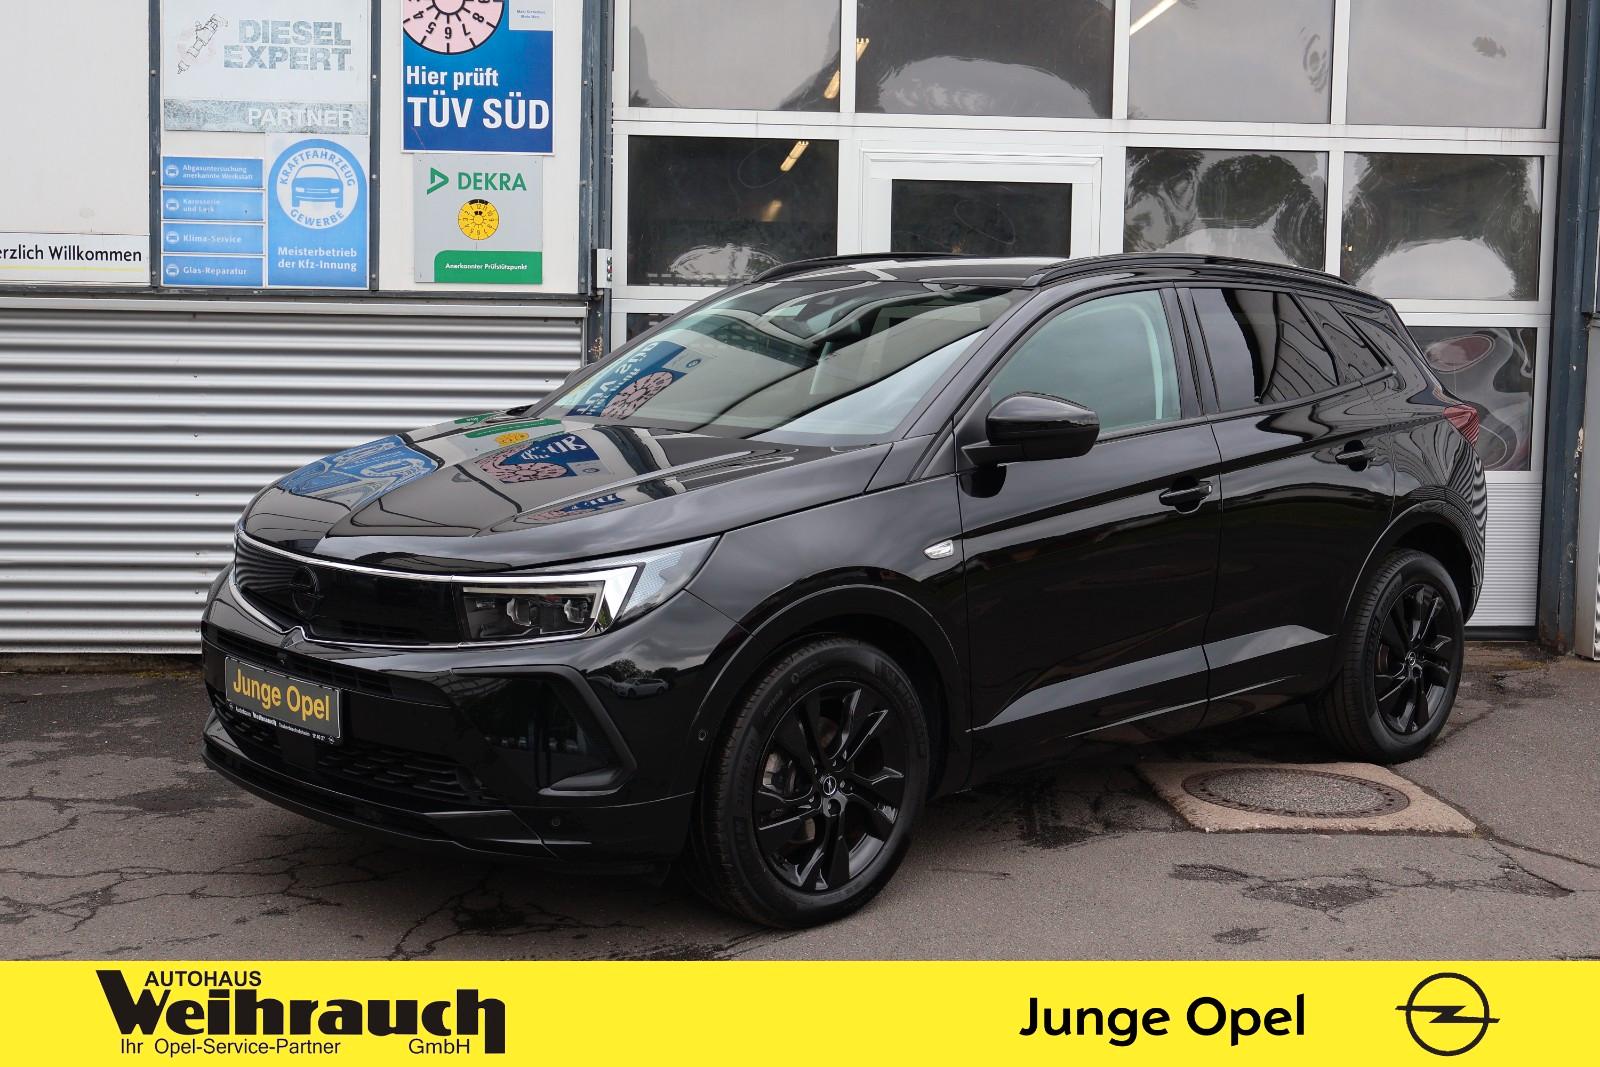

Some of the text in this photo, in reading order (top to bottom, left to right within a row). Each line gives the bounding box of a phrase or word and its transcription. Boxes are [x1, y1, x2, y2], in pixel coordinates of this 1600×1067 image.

[239, 20, 351, 45] DIESEL
[223, 45, 351, 71] EXPERT
[407, 65, 499, 91] Hier prüft
[248, 106, 353, 129] PARTNER
[407, 89, 550, 130] TÜV SÜD
[279, 150, 356, 187] KRAFTFAHRZEUG
[458, 172, 527, 191] DEKRA
[290, 208, 345, 227] GEWERBE
[183, 234, 242, 243] Klima-Service
[0, 243, 142, 262] rzlich Willkommen
[278, 246, 357, 257] Meisterbetrieb
[183, 266, 247, 277] Glas-Reparatur
[278, 259, 357, 273] der Kfz-Innung
[484, 262, 528, 271] Prüfstützpunkt
[233, 668, 330, 722] Junge Opel
